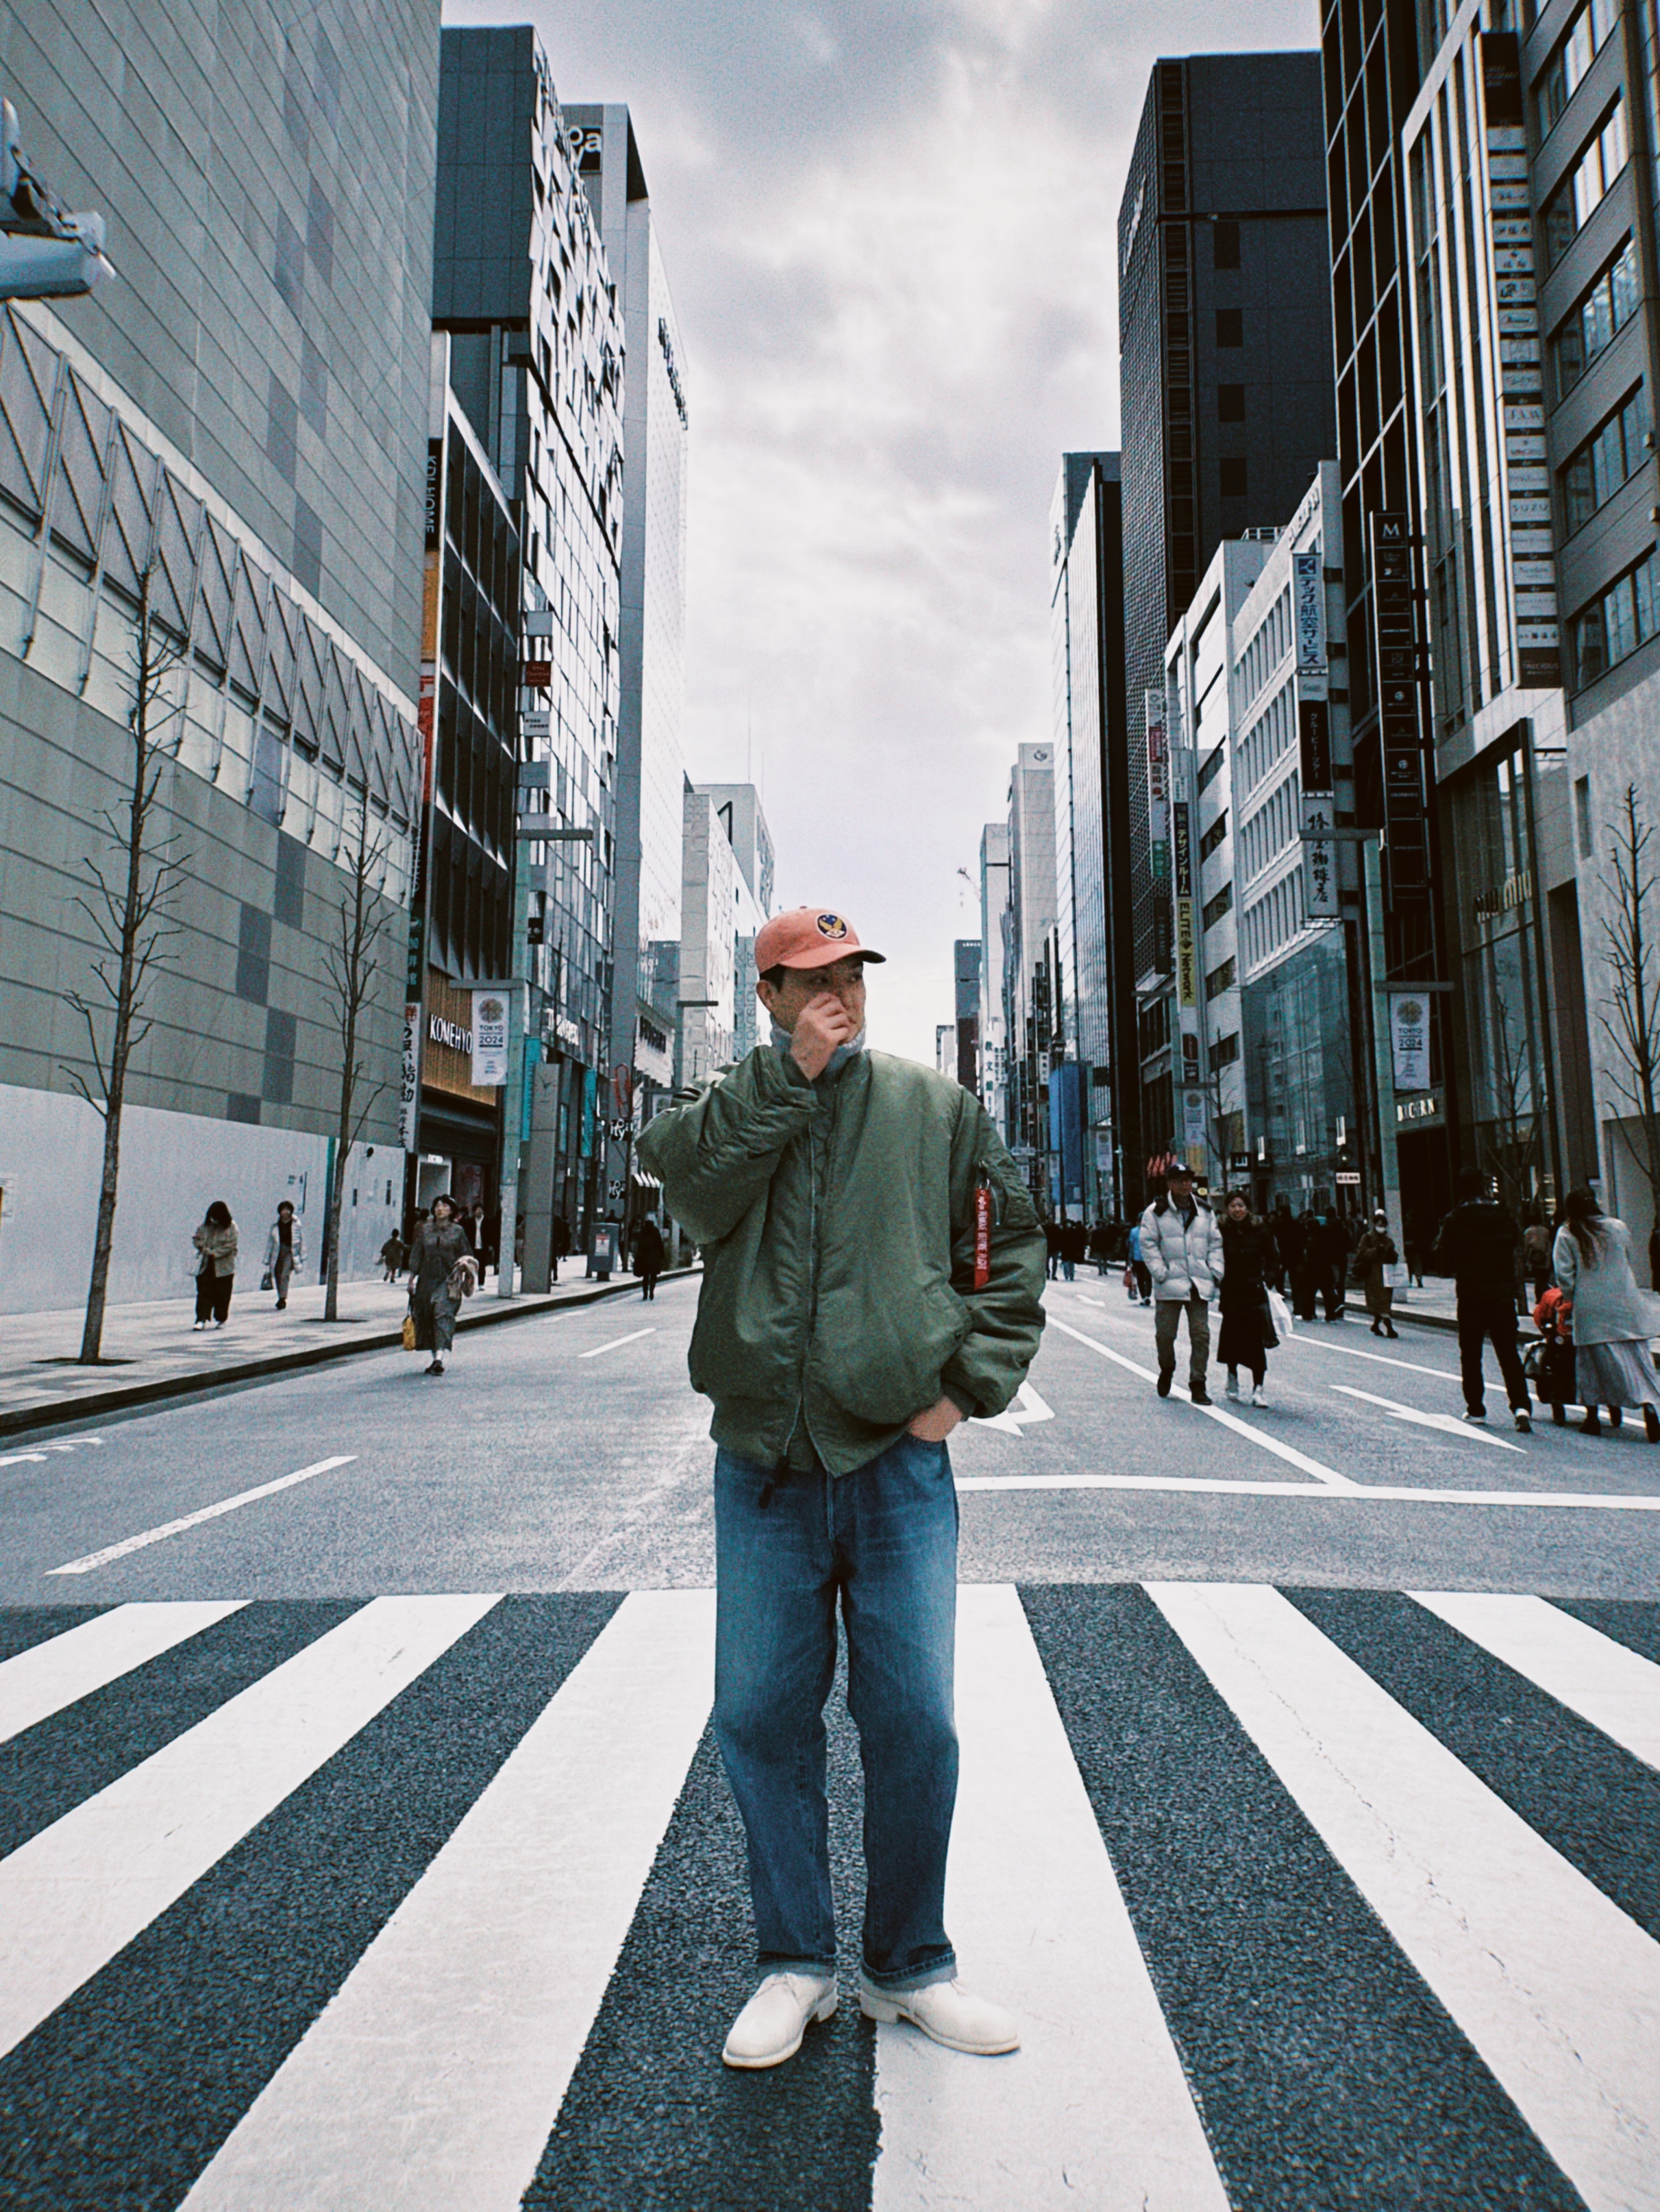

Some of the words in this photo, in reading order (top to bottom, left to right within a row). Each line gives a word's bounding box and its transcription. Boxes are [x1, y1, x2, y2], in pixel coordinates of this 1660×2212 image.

[1382, 523, 1401, 536] M
[1300, 576, 1320, 664] テック航空サービス
[1180, 902, 1191, 938] ELITE
[1181, 953, 1193, 999] Network
[430, 1014, 473, 1054] KOMEHYO
[1398, 1039, 1423, 1047] 2024
[985, 1041, 993, 1091] 教文館
[978, 1210, 988, 1230] REMOVE
[977, 1232, 987, 1250] BEFORE
[976, 1253, 987, 1270] FLIGHT
